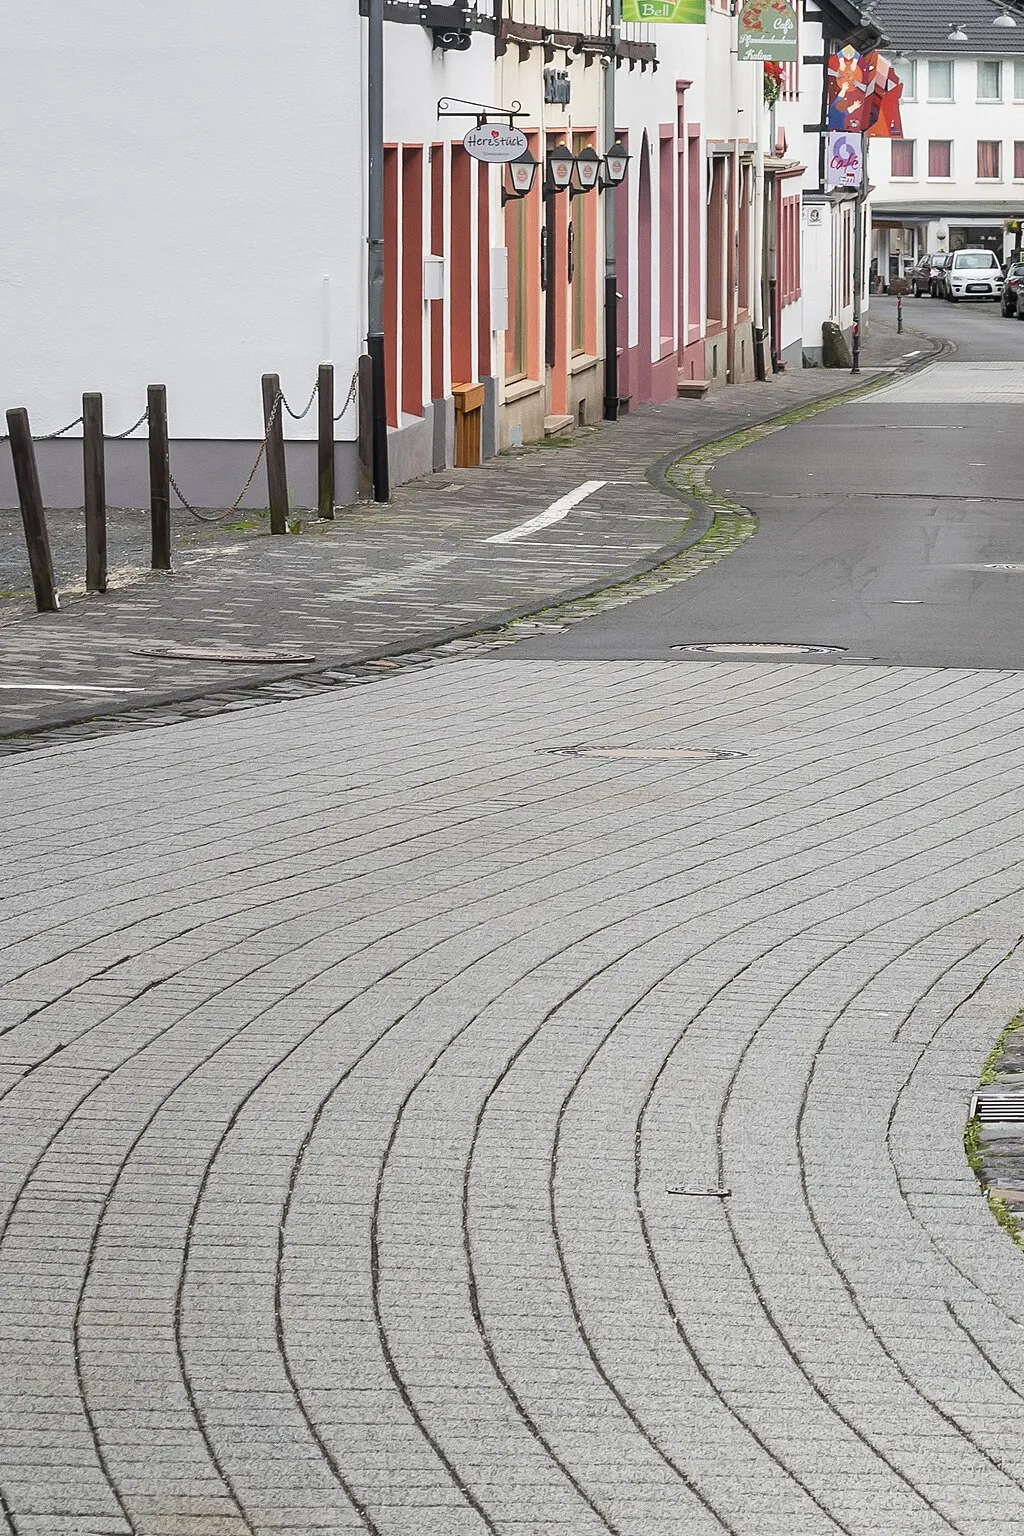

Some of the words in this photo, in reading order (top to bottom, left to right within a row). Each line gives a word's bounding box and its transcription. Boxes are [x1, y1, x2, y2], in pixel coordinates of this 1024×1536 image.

[642, 3, 669, 16] Bell
[468, 134, 523, 146] Herzstück
[829, 152, 859, 173] Café
